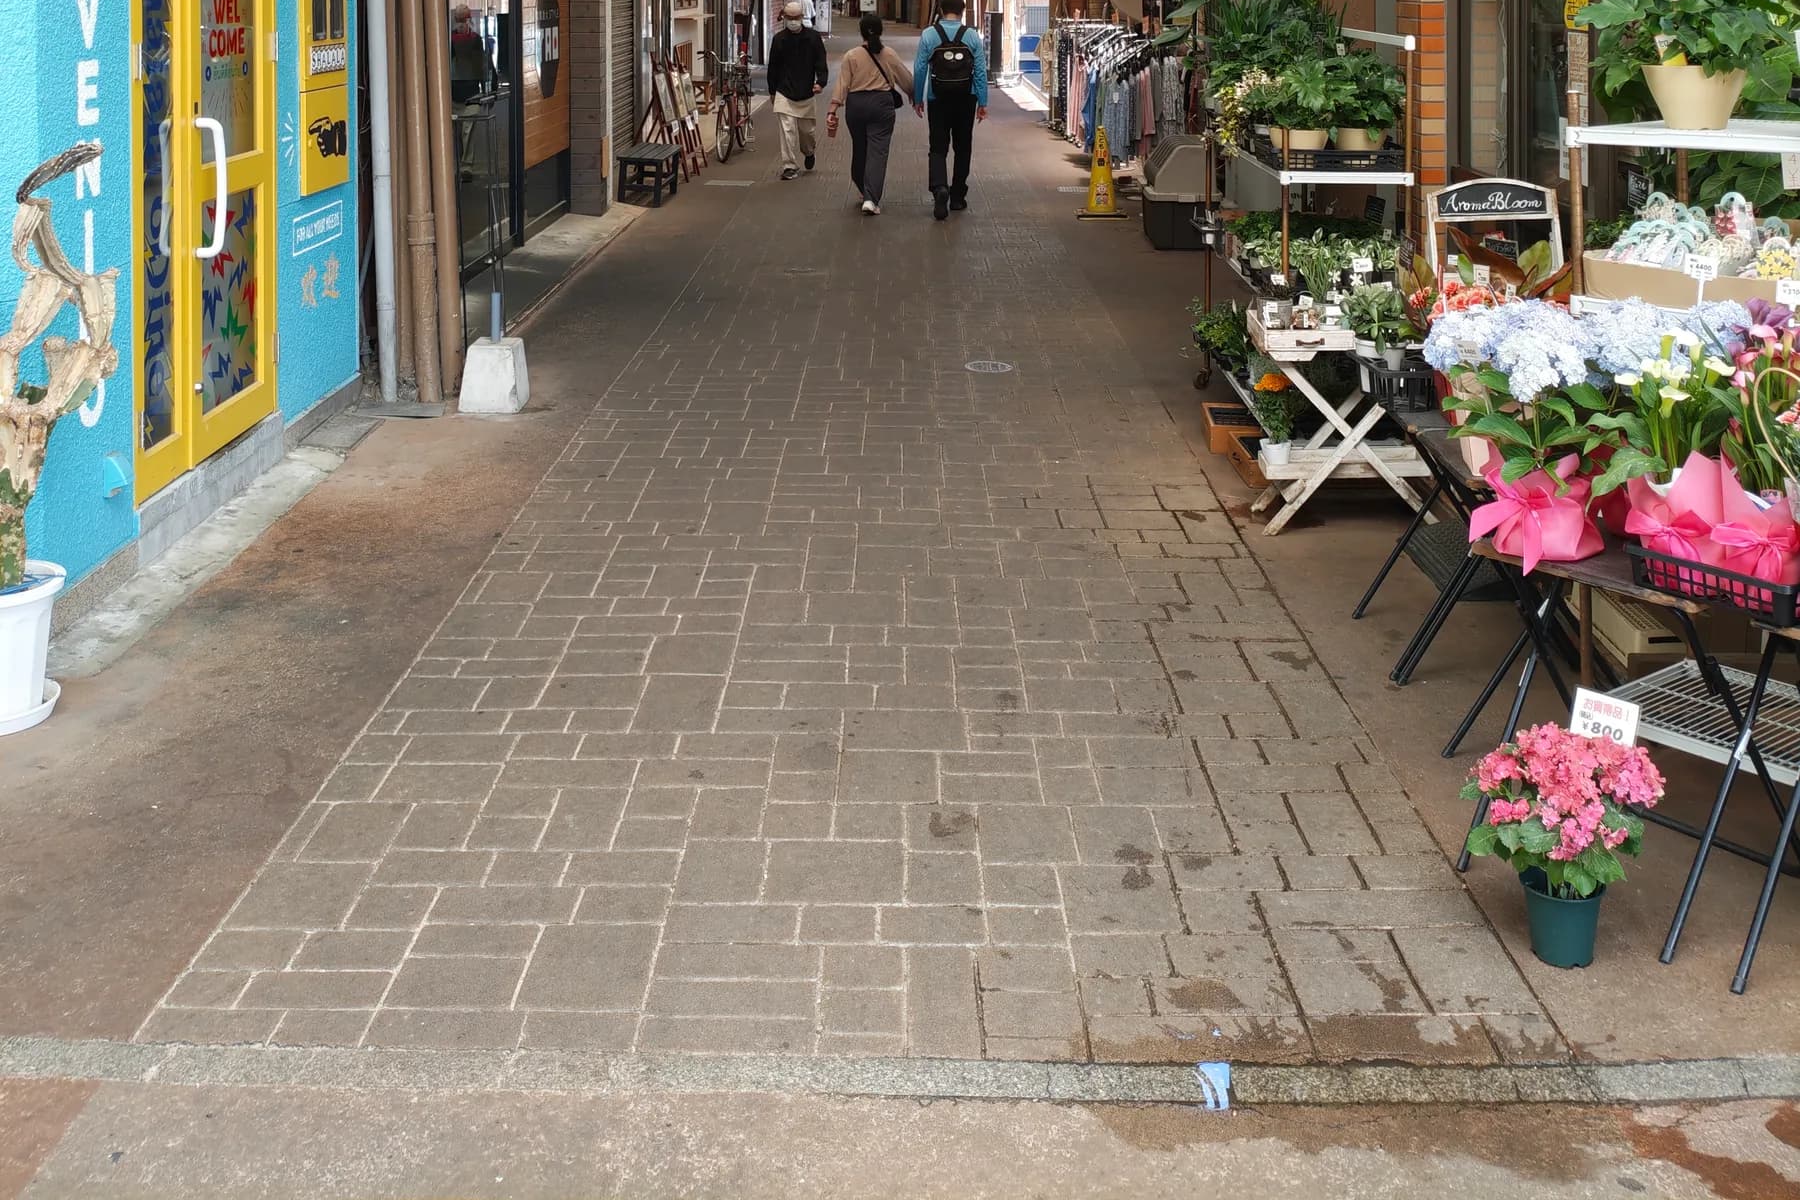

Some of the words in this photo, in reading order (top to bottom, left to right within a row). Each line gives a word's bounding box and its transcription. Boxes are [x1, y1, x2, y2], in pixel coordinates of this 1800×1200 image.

[208, 26, 245, 58] COME
[312, 47, 346, 70] SHALALA
[1440, 191, 1543, 213] AromaBloom
